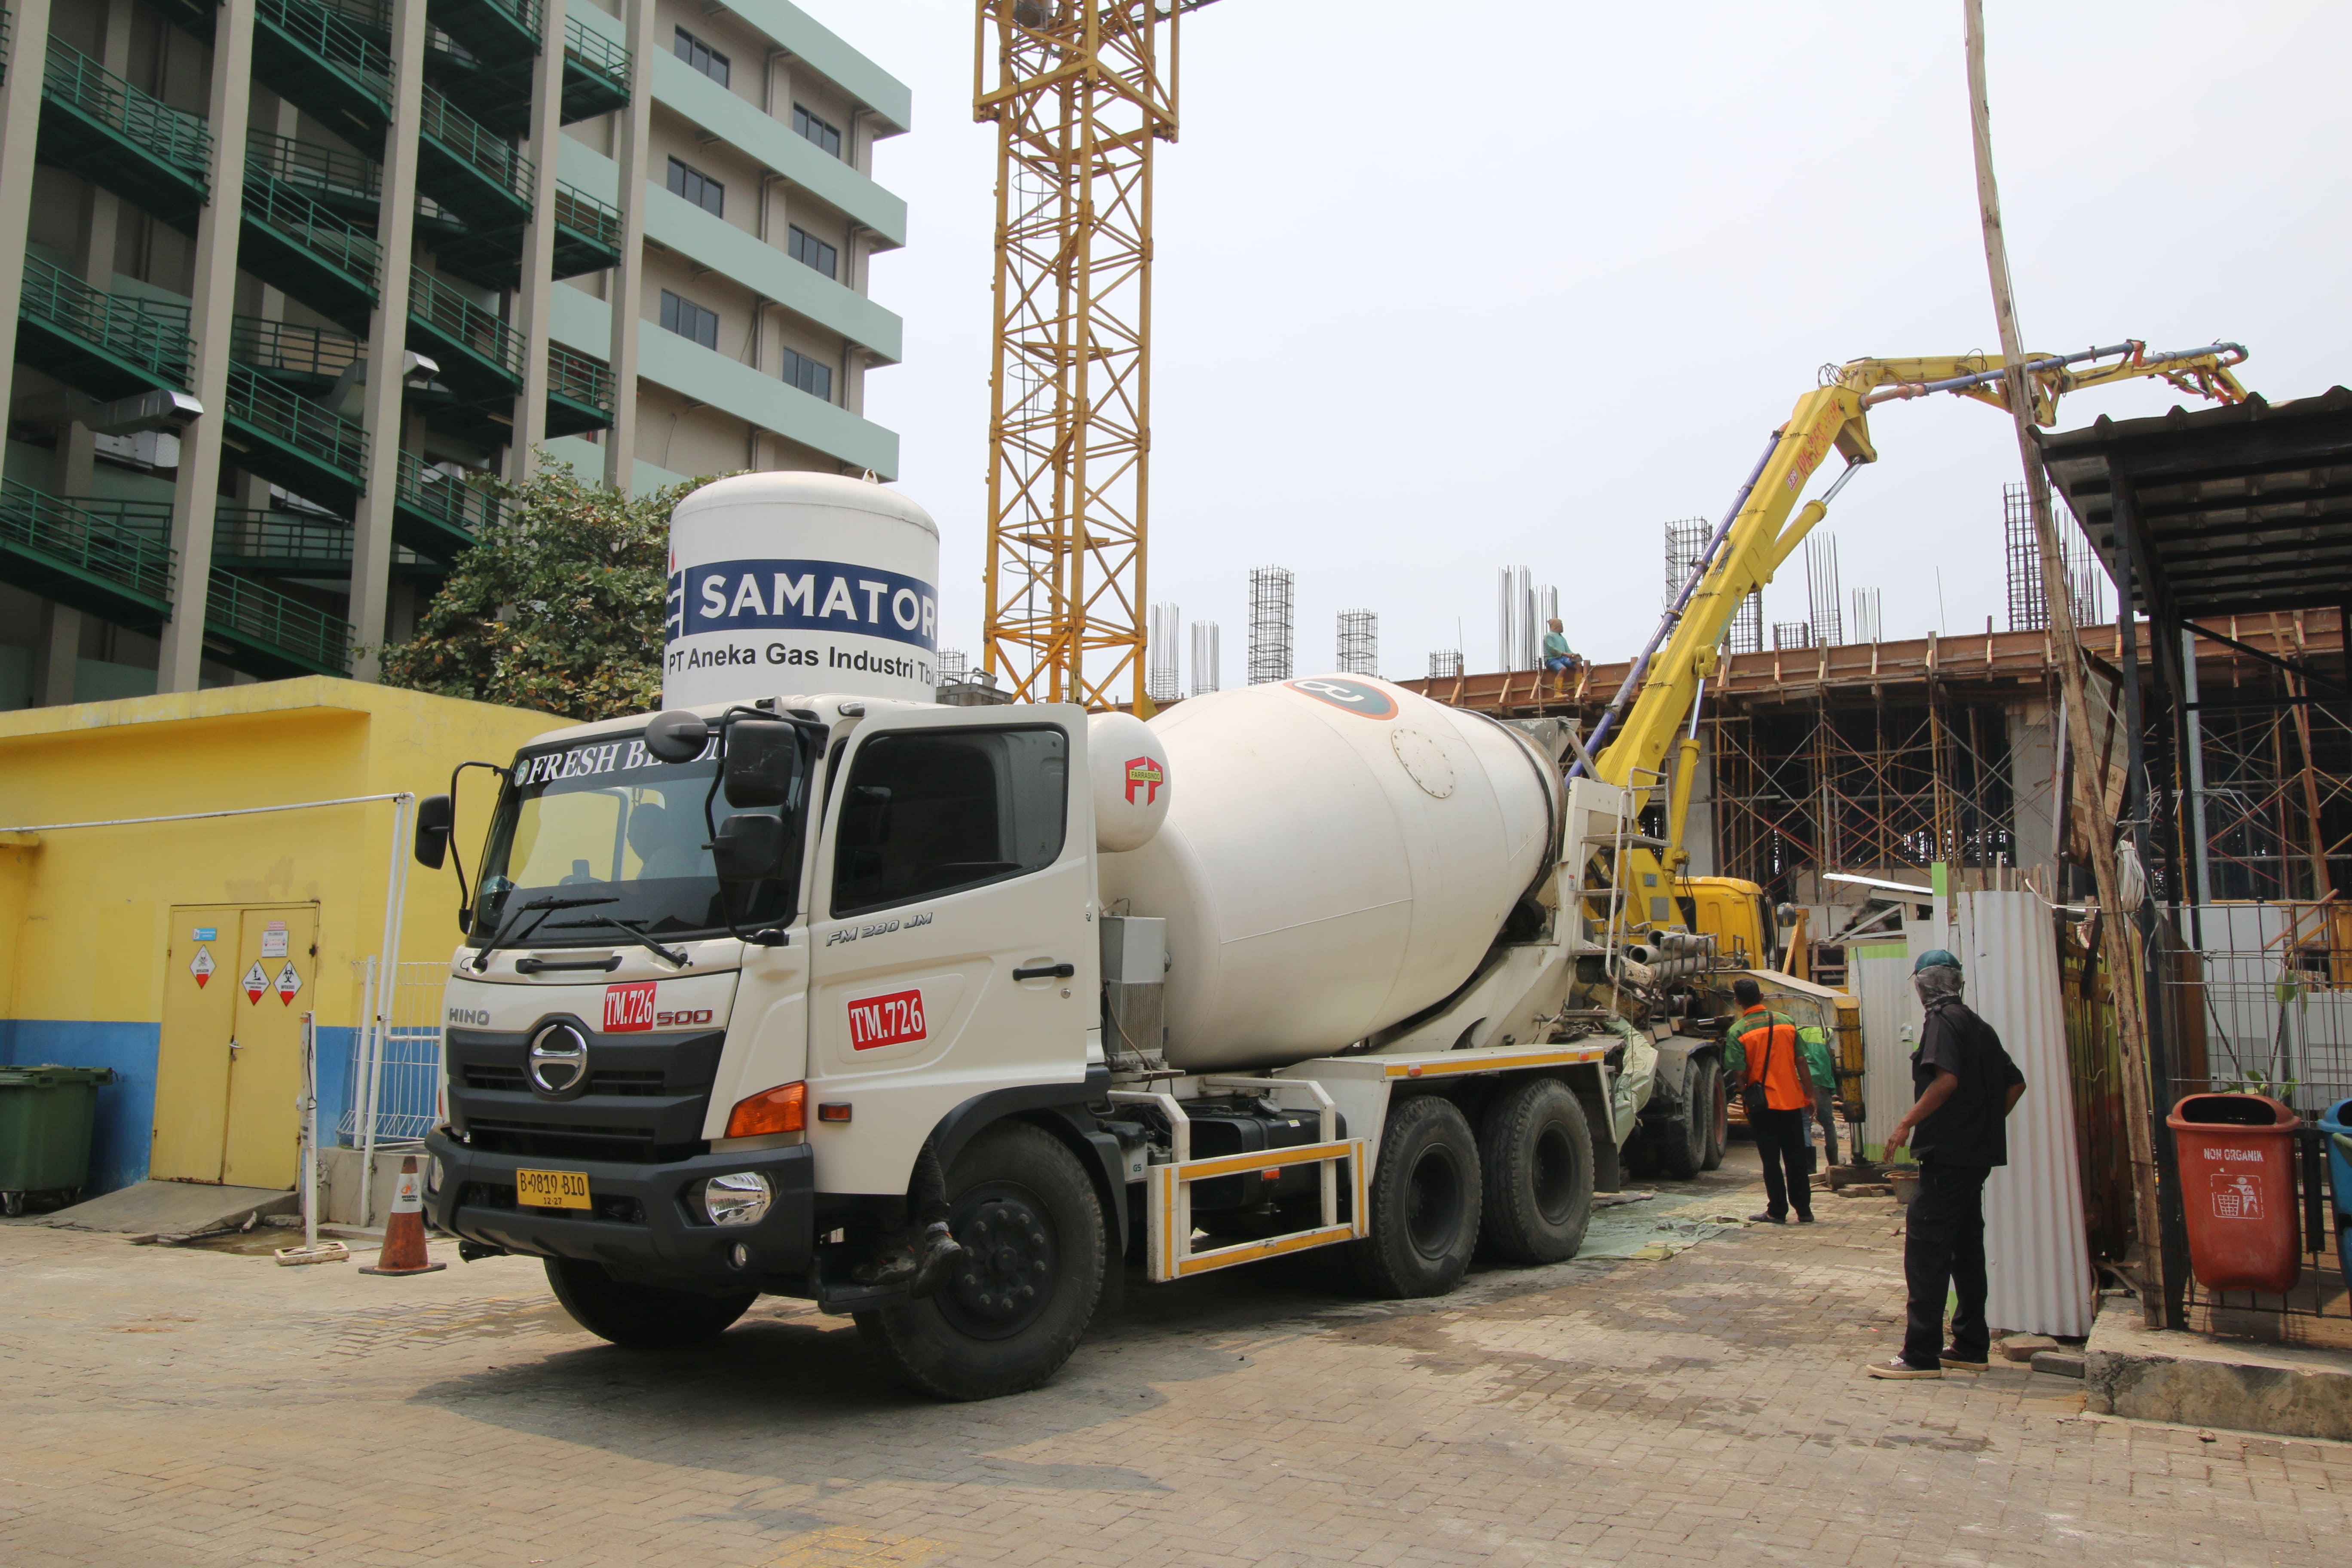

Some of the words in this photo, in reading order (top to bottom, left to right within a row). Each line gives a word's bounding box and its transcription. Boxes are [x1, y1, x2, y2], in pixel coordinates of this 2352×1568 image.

[699, 573, 936, 641] SAMATOR
[669, 650, 684, 675] PT
[687, 643, 756, 670] Aneka
[766, 642, 819, 667] Gas
[829, 646, 913, 680] Industri
[918, 661, 935, 688] Tbk
[526, 743, 622, 785] FRESH
[826, 927, 858, 946] FM
[861, 920, 899, 939] 280
[903, 912, 933, 929] JM
[449, 1008, 490, 1026] HINO
[606, 988, 654, 1026] TM.726
[656, 1008, 713, 1026] 500
[851, 997, 923, 1043] TM.726
[1133, 1164, 1142, 1172] GS
[2204, 1148, 2222, 1160] NON
[2224, 1148, 2264, 1161] ORGANIK
[520, 1173, 527, 1191] B
[530, 1173, 557, 1194] 9819
